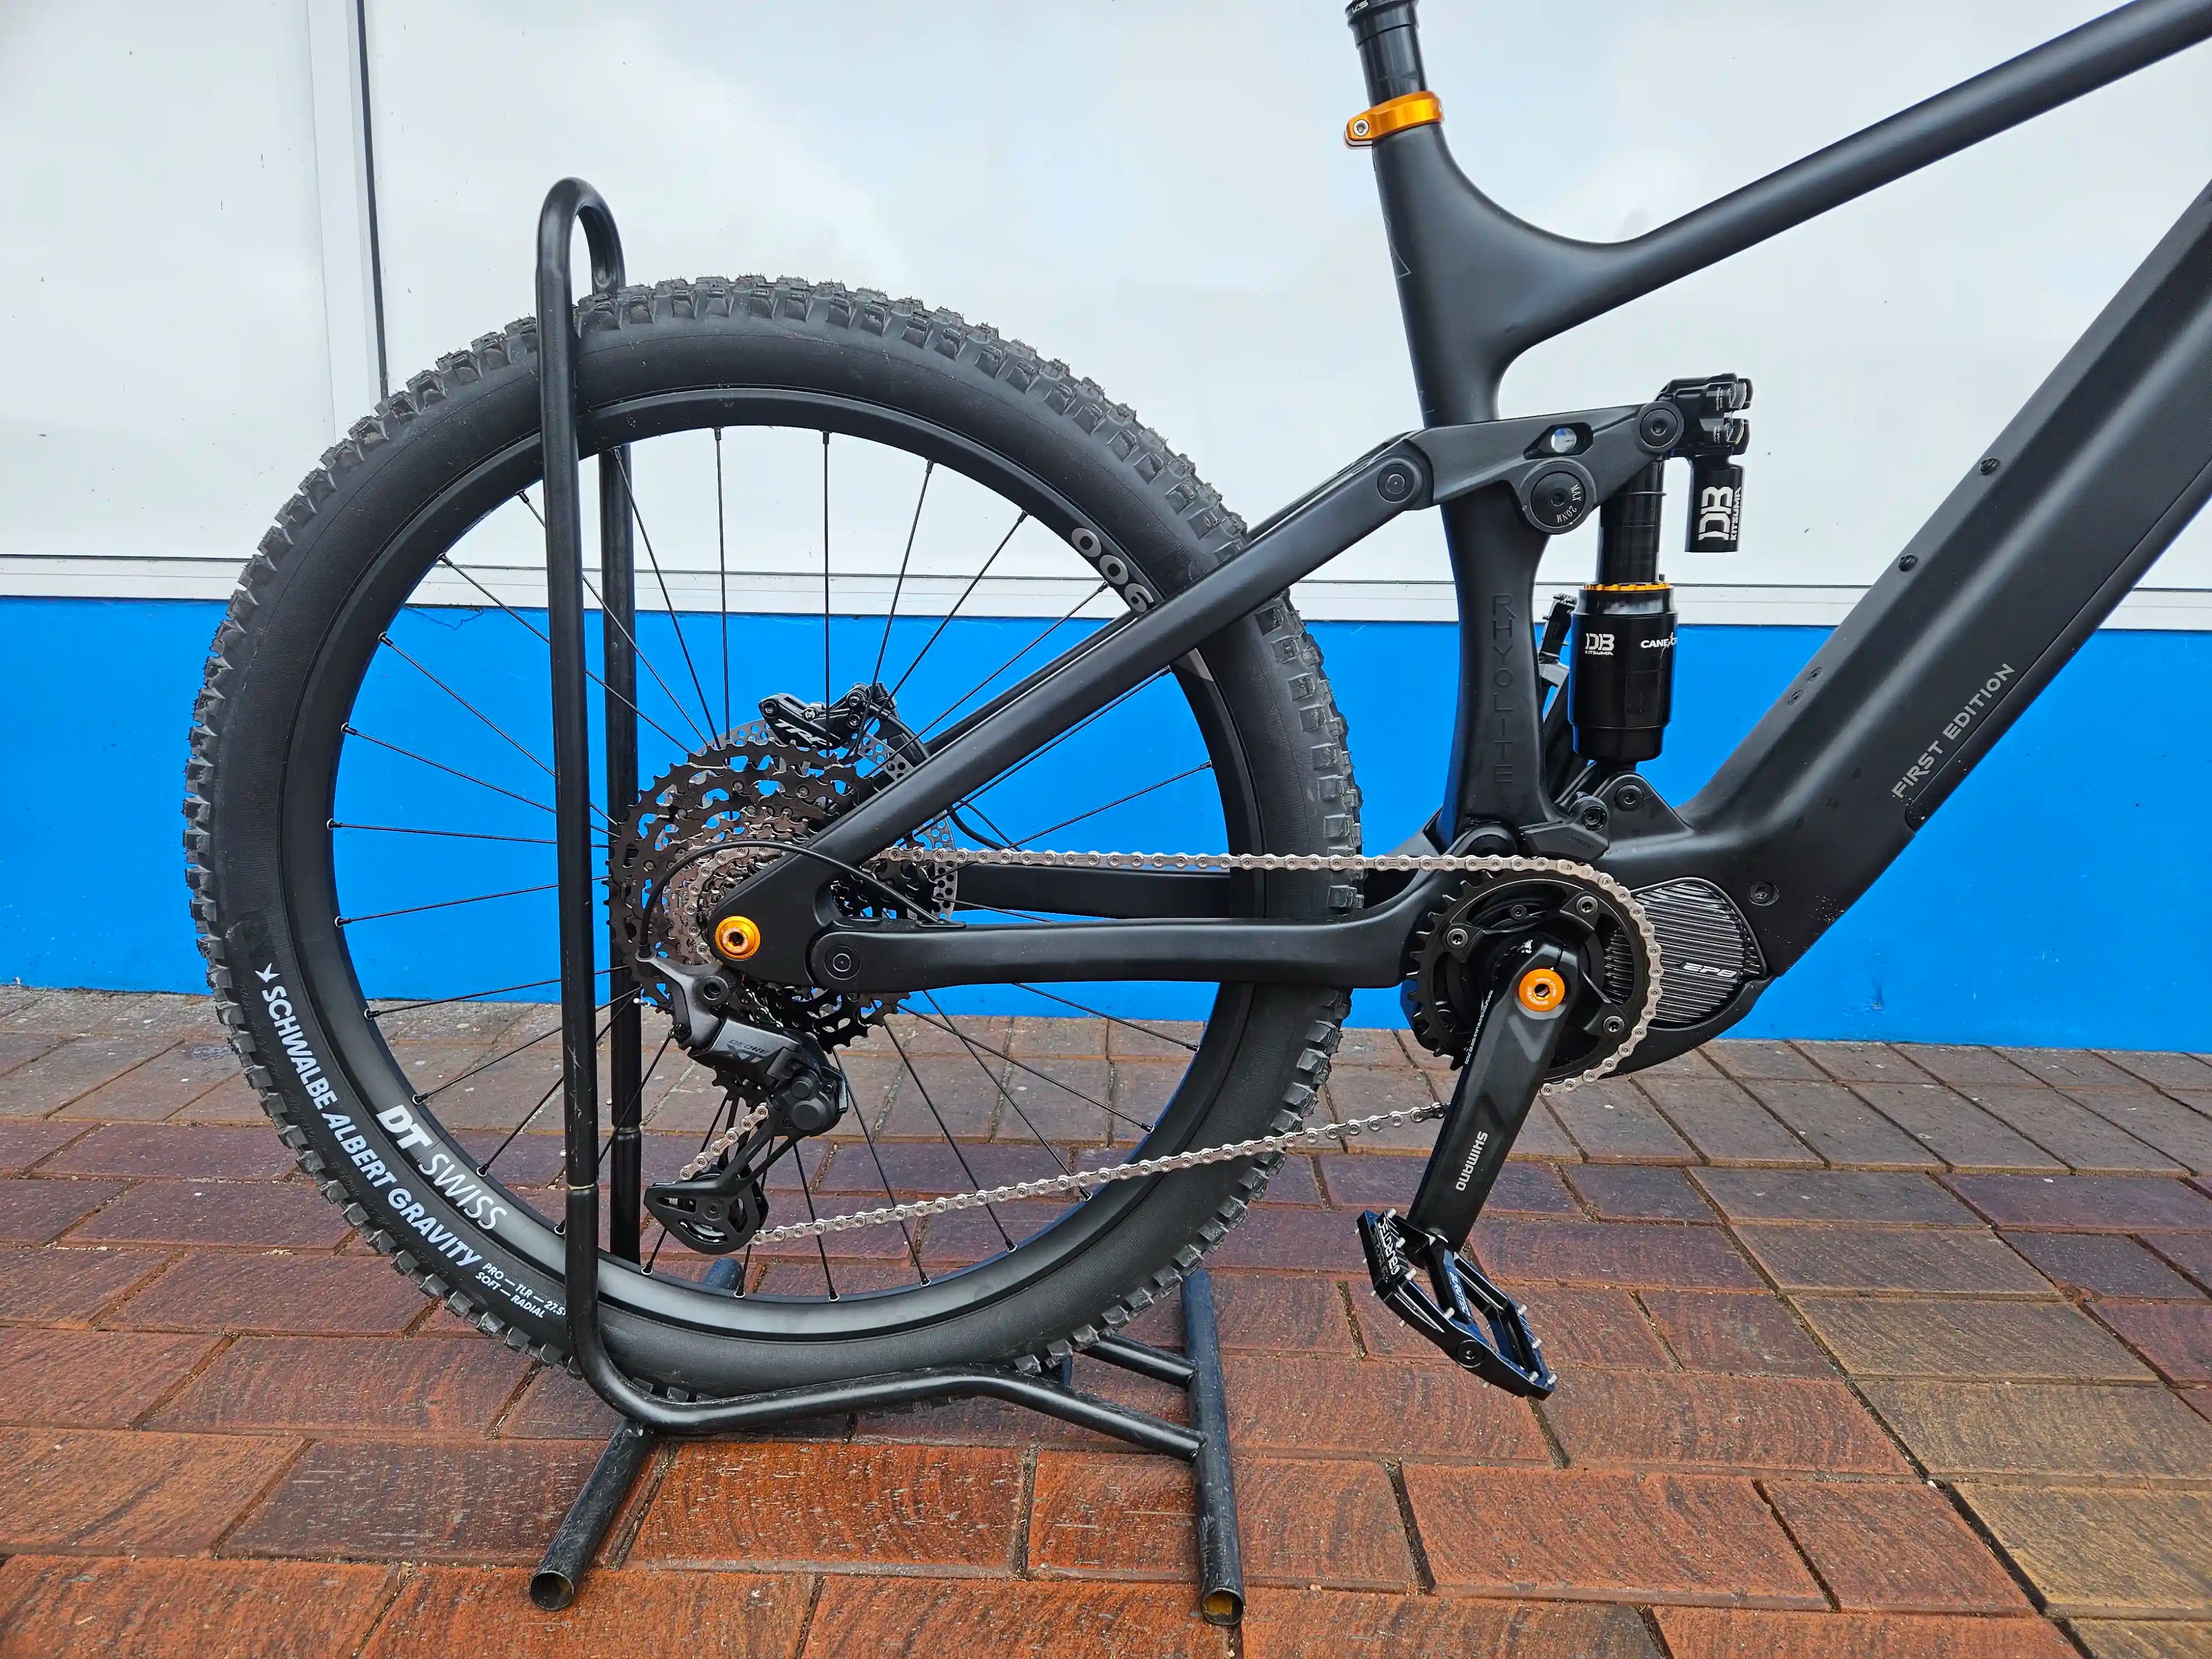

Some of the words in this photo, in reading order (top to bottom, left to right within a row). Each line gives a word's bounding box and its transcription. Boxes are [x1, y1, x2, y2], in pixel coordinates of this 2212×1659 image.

[1571, 484, 1582, 502] MAX
[1730, 487, 1741, 540] KITSUMA
[1493, 593, 1518, 783] RHYOLITE
[774, 718, 833, 747] TRP
[1891, 740, 1943, 799] FIRST
[1942, 663, 2015, 740] EDITION
[1683, 962, 1738, 978] EP8
[263, 985, 337, 1110] SCHWALBE
[322, 1112, 396, 1189] ALBERT
[388, 1188, 482, 1266] GRAVITY
[376, 1104, 433, 1150] DT
[418, 1153, 507, 1230] SWISS
[1455, 1131, 1488, 1191] SHIMANO
[476, 1272, 501, 1290] SOFT
[511, 1295, 545, 1318] RADIAL
[482, 1262, 504, 1279] PRO
[515, 1284, 533, 1298] TLR
